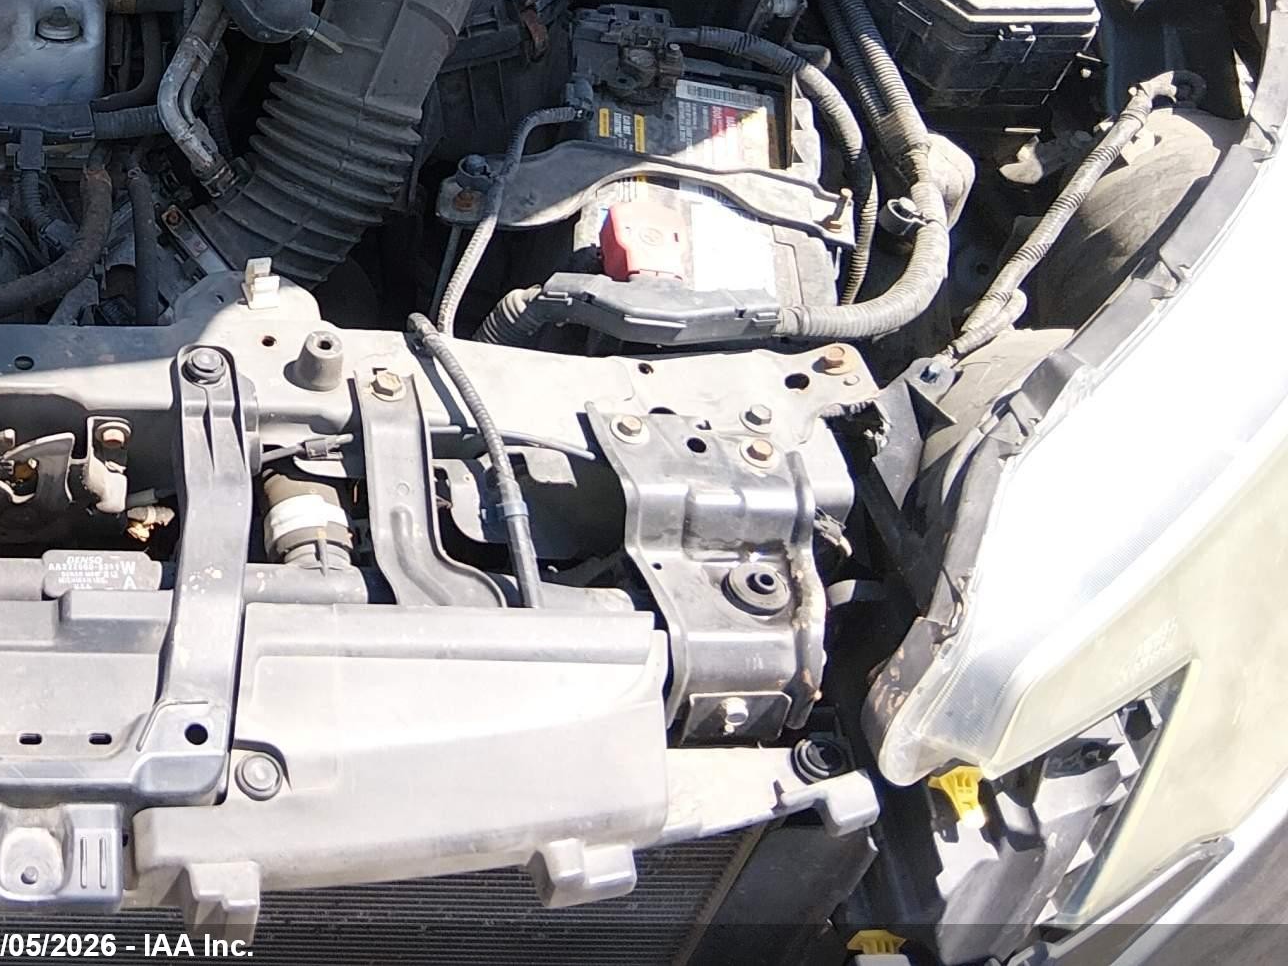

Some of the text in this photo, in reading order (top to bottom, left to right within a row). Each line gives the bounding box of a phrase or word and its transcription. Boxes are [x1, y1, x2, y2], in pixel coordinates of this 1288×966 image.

[66, 556, 103, 564] DENSO
[120, 561, 136, 575] W
[123, 575, 137, 590] A
